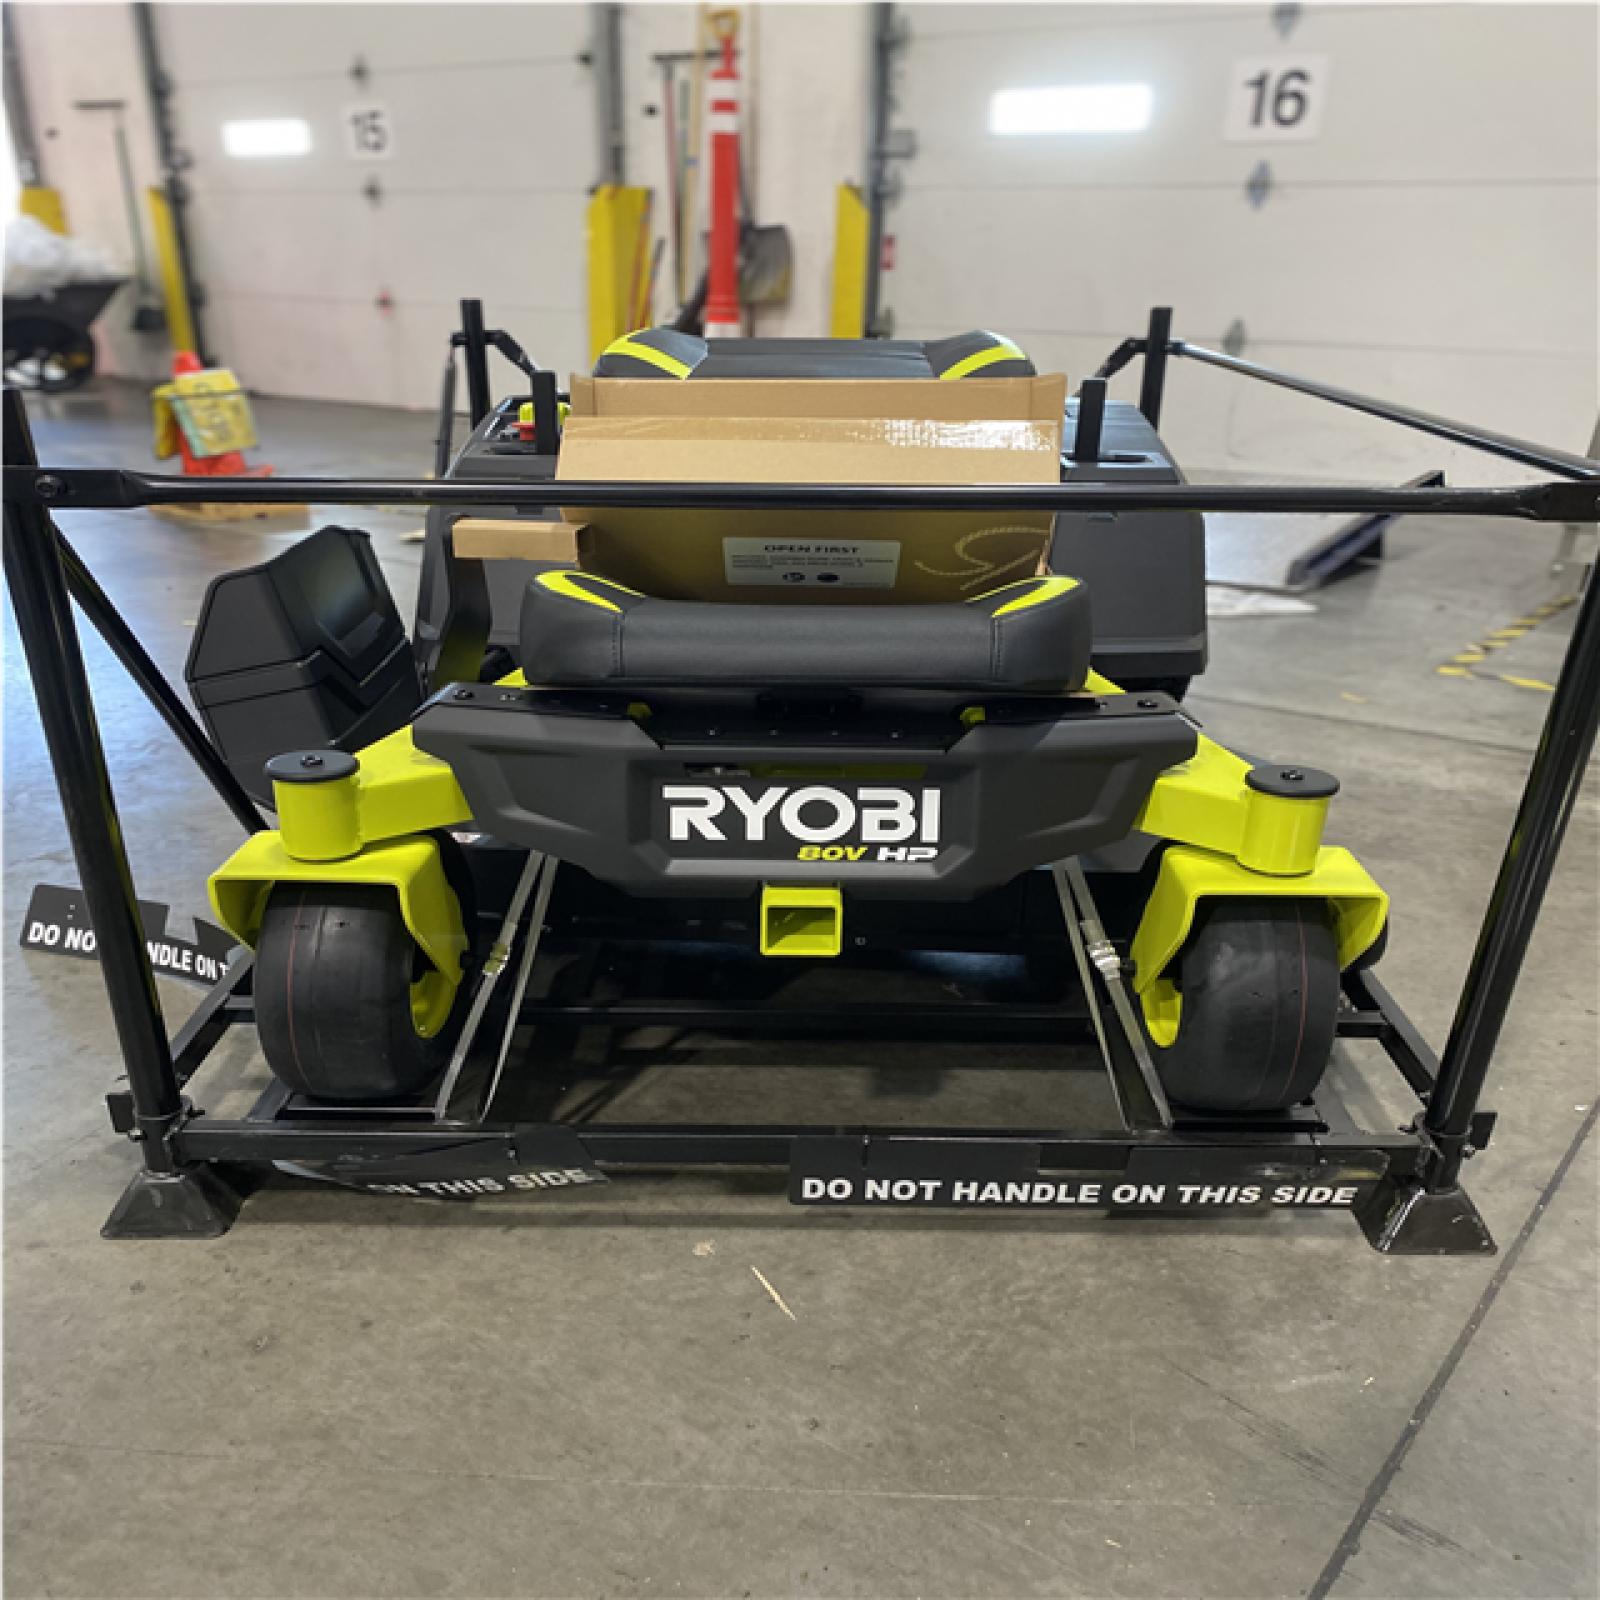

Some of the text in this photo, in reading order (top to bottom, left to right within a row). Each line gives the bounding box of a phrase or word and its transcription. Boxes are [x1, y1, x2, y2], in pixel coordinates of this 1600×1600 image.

[1243, 68, 1313, 128] 16
[350, 110, 388, 151] 15
[764, 544, 861, 554] OPEN FIRST
[662, 784, 941, 843] RYOBI
[797, 845, 938, 861] 80V HP
[27, 921, 60, 946] DO
[64, 927, 97, 952] NO
[146, 940, 193, 971] NDLE
[195, 953, 218, 980] ON
[802, 1177, 1359, 1204] DO NOT HANDLE ON THIS SIDE
